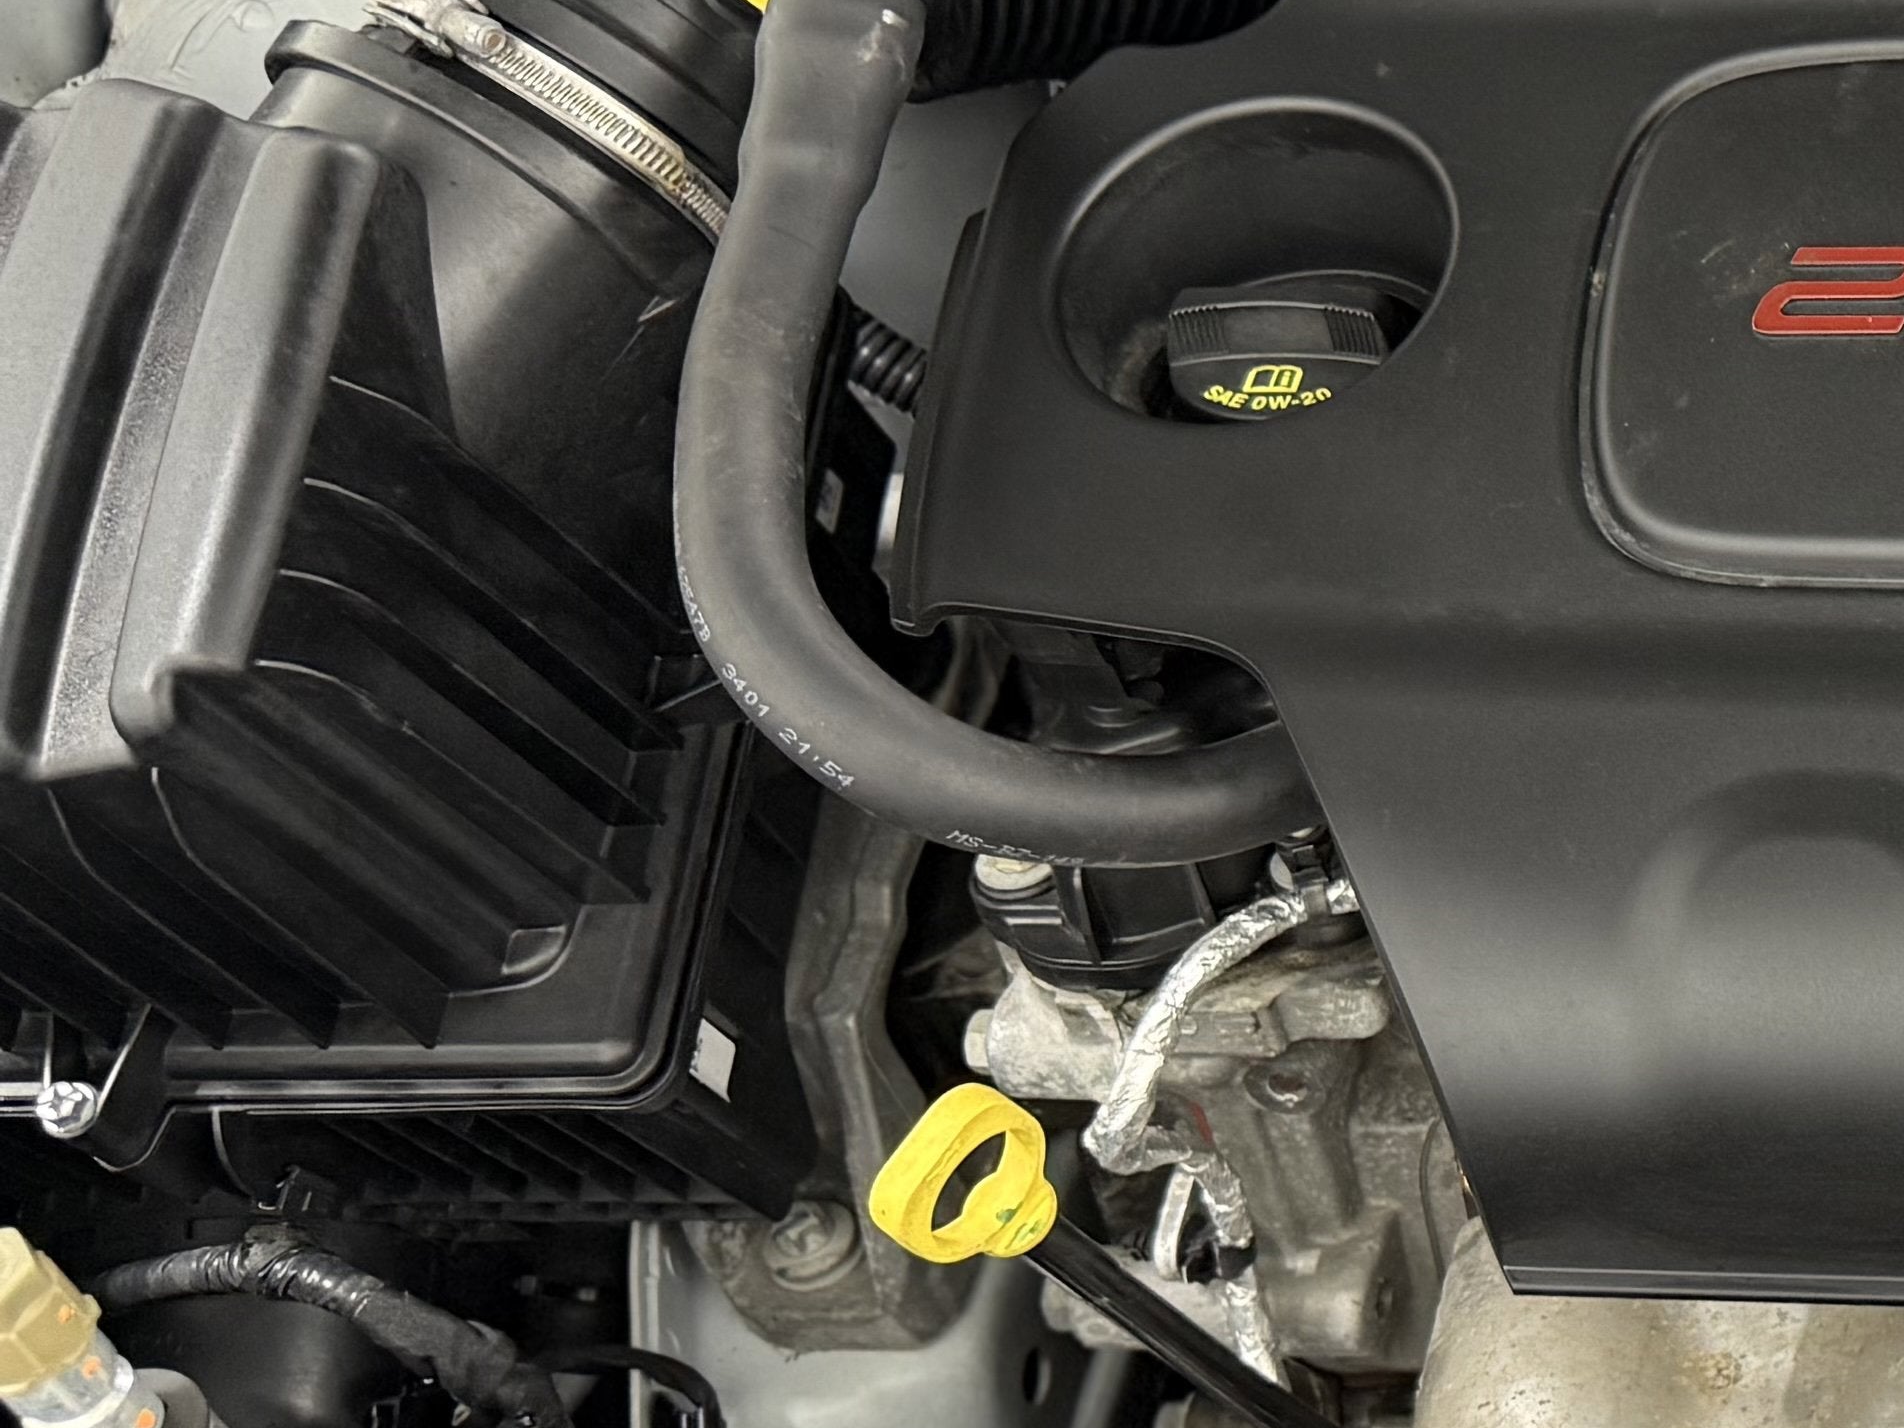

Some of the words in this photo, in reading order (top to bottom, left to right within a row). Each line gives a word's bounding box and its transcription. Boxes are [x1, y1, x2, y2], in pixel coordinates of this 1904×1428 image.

[1203, 384, 1248, 410] SAE
[1251, 387, 1333, 411] 0W-20
[721, 662, 770, 720] 3401
